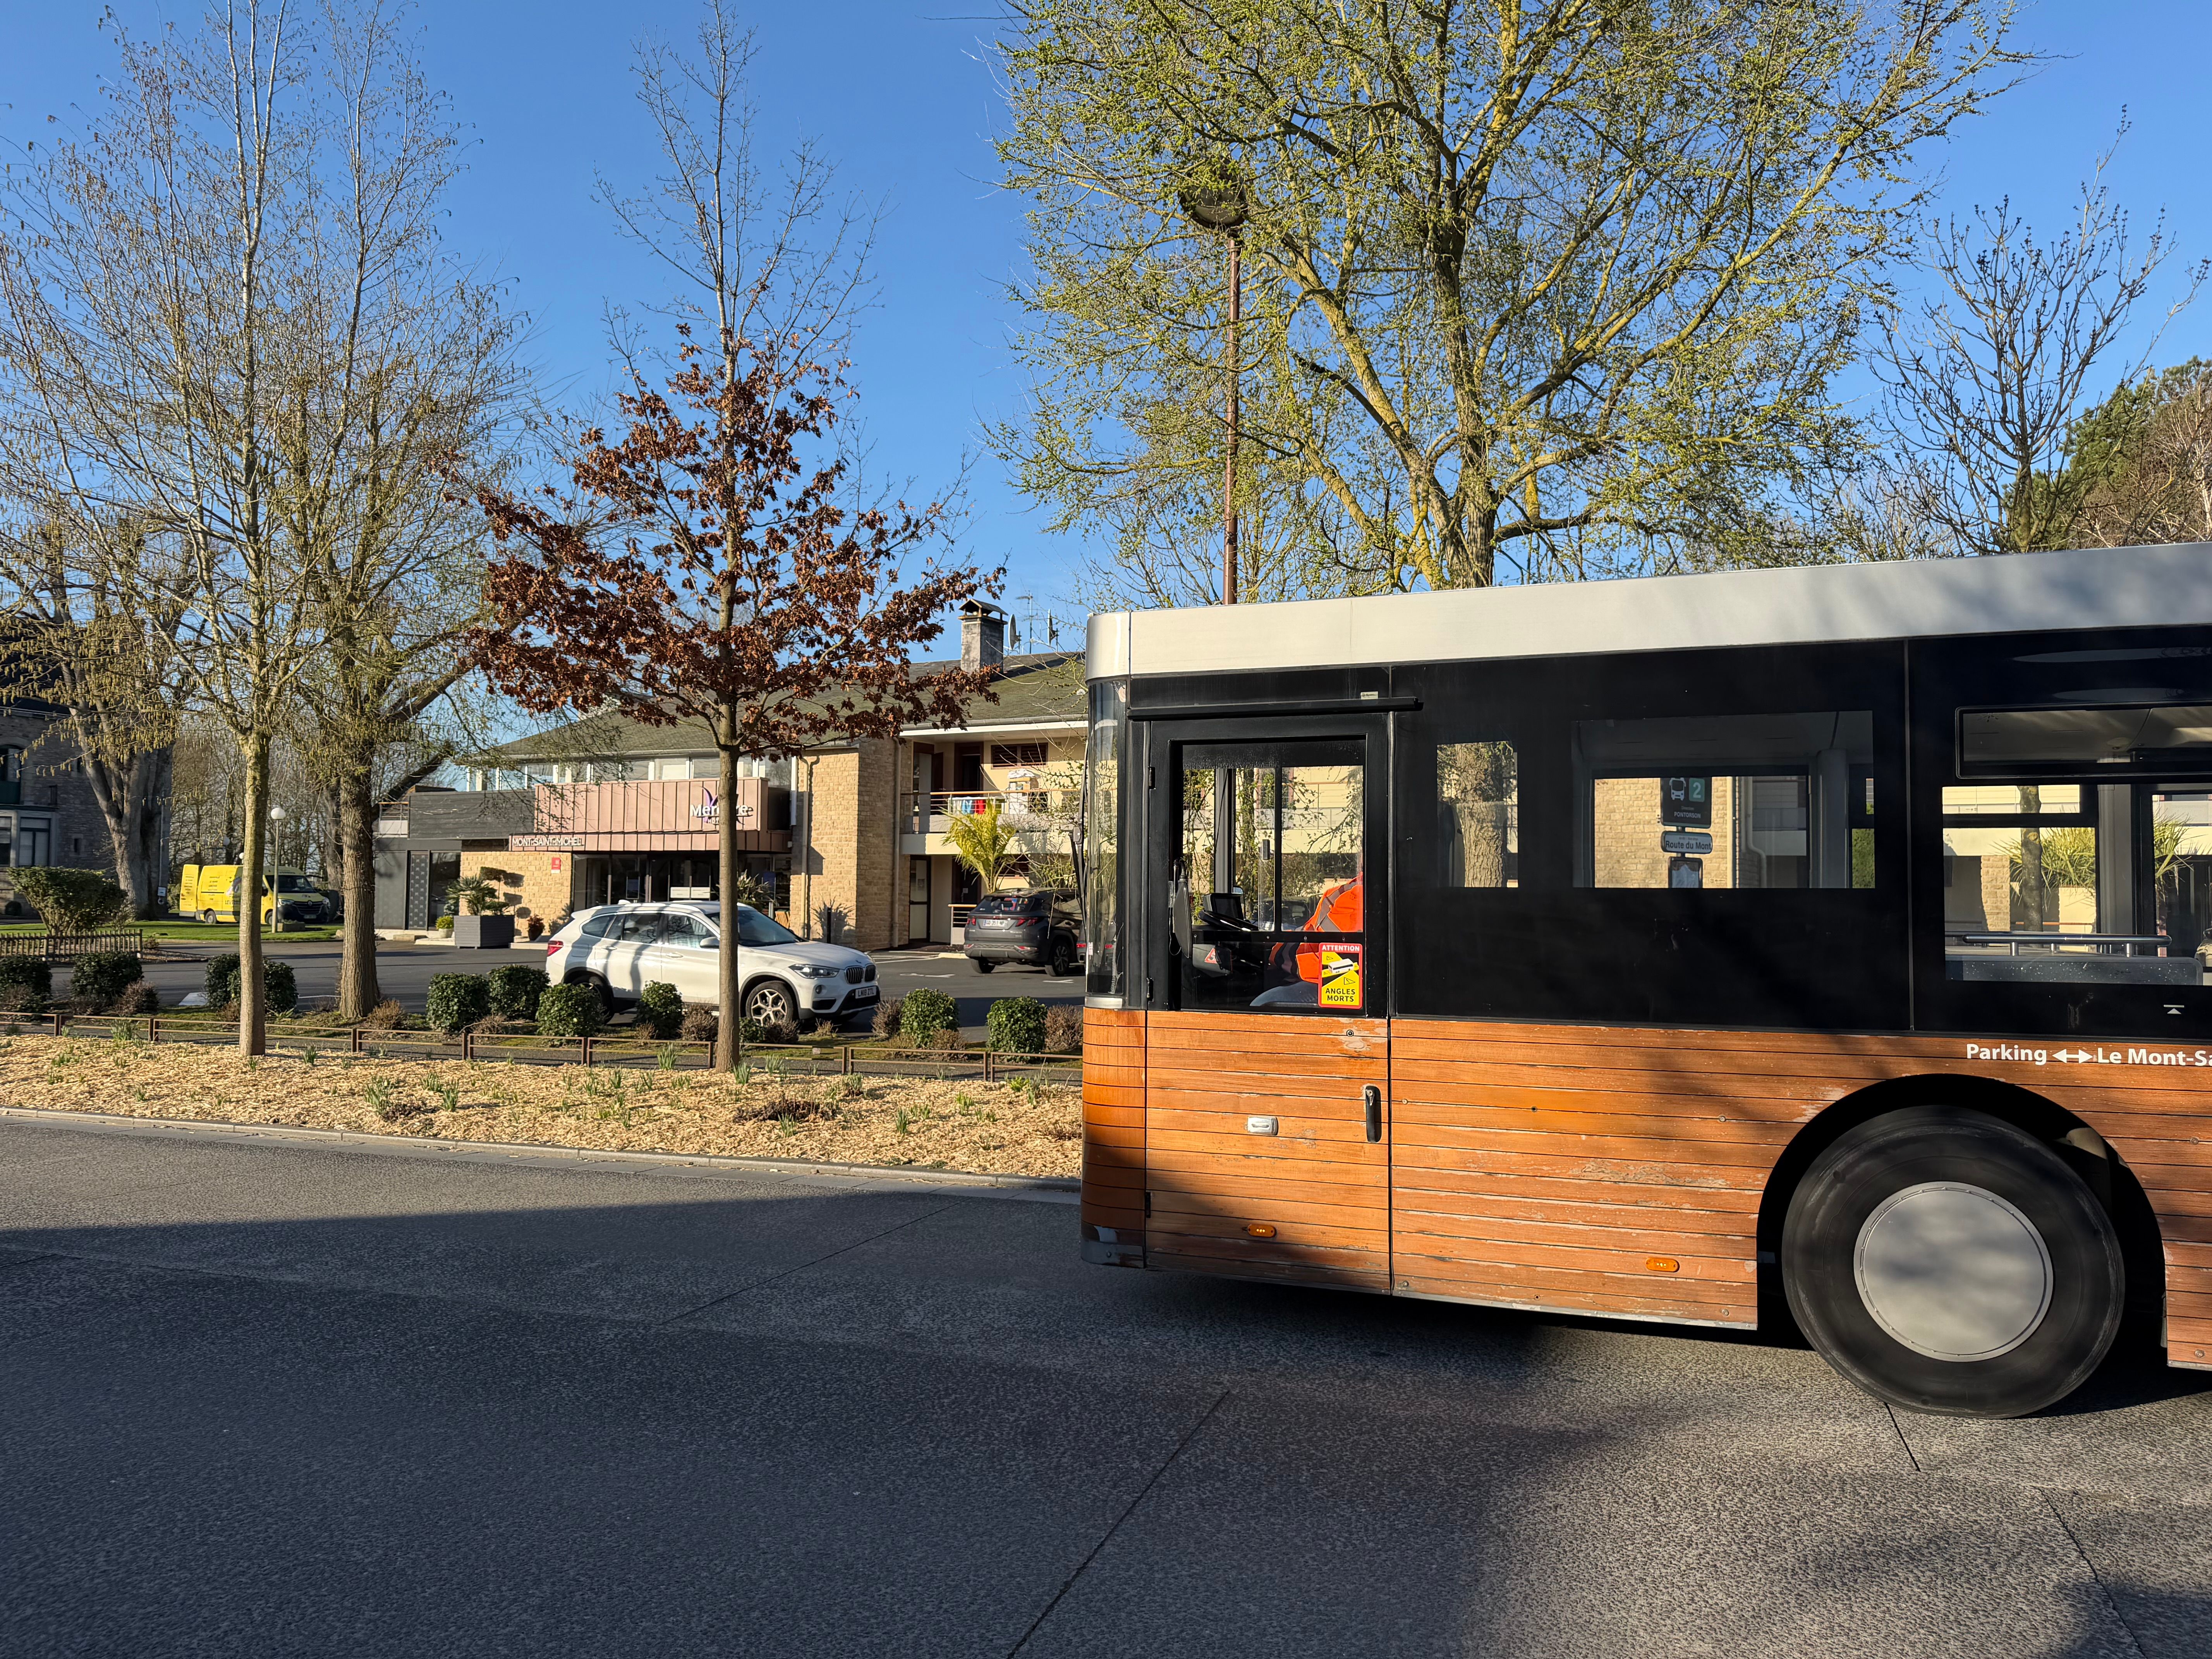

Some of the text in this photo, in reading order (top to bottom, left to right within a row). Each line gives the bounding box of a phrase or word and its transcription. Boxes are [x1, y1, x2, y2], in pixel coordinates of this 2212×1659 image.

[1693, 782, 1701, 798] 2
[1666, 840, 1684, 848] Route
[1686, 841, 1693, 849] du
[1966, 1044, 2047, 1065] Parking
[2098, 1048, 2122, 1063] Le
